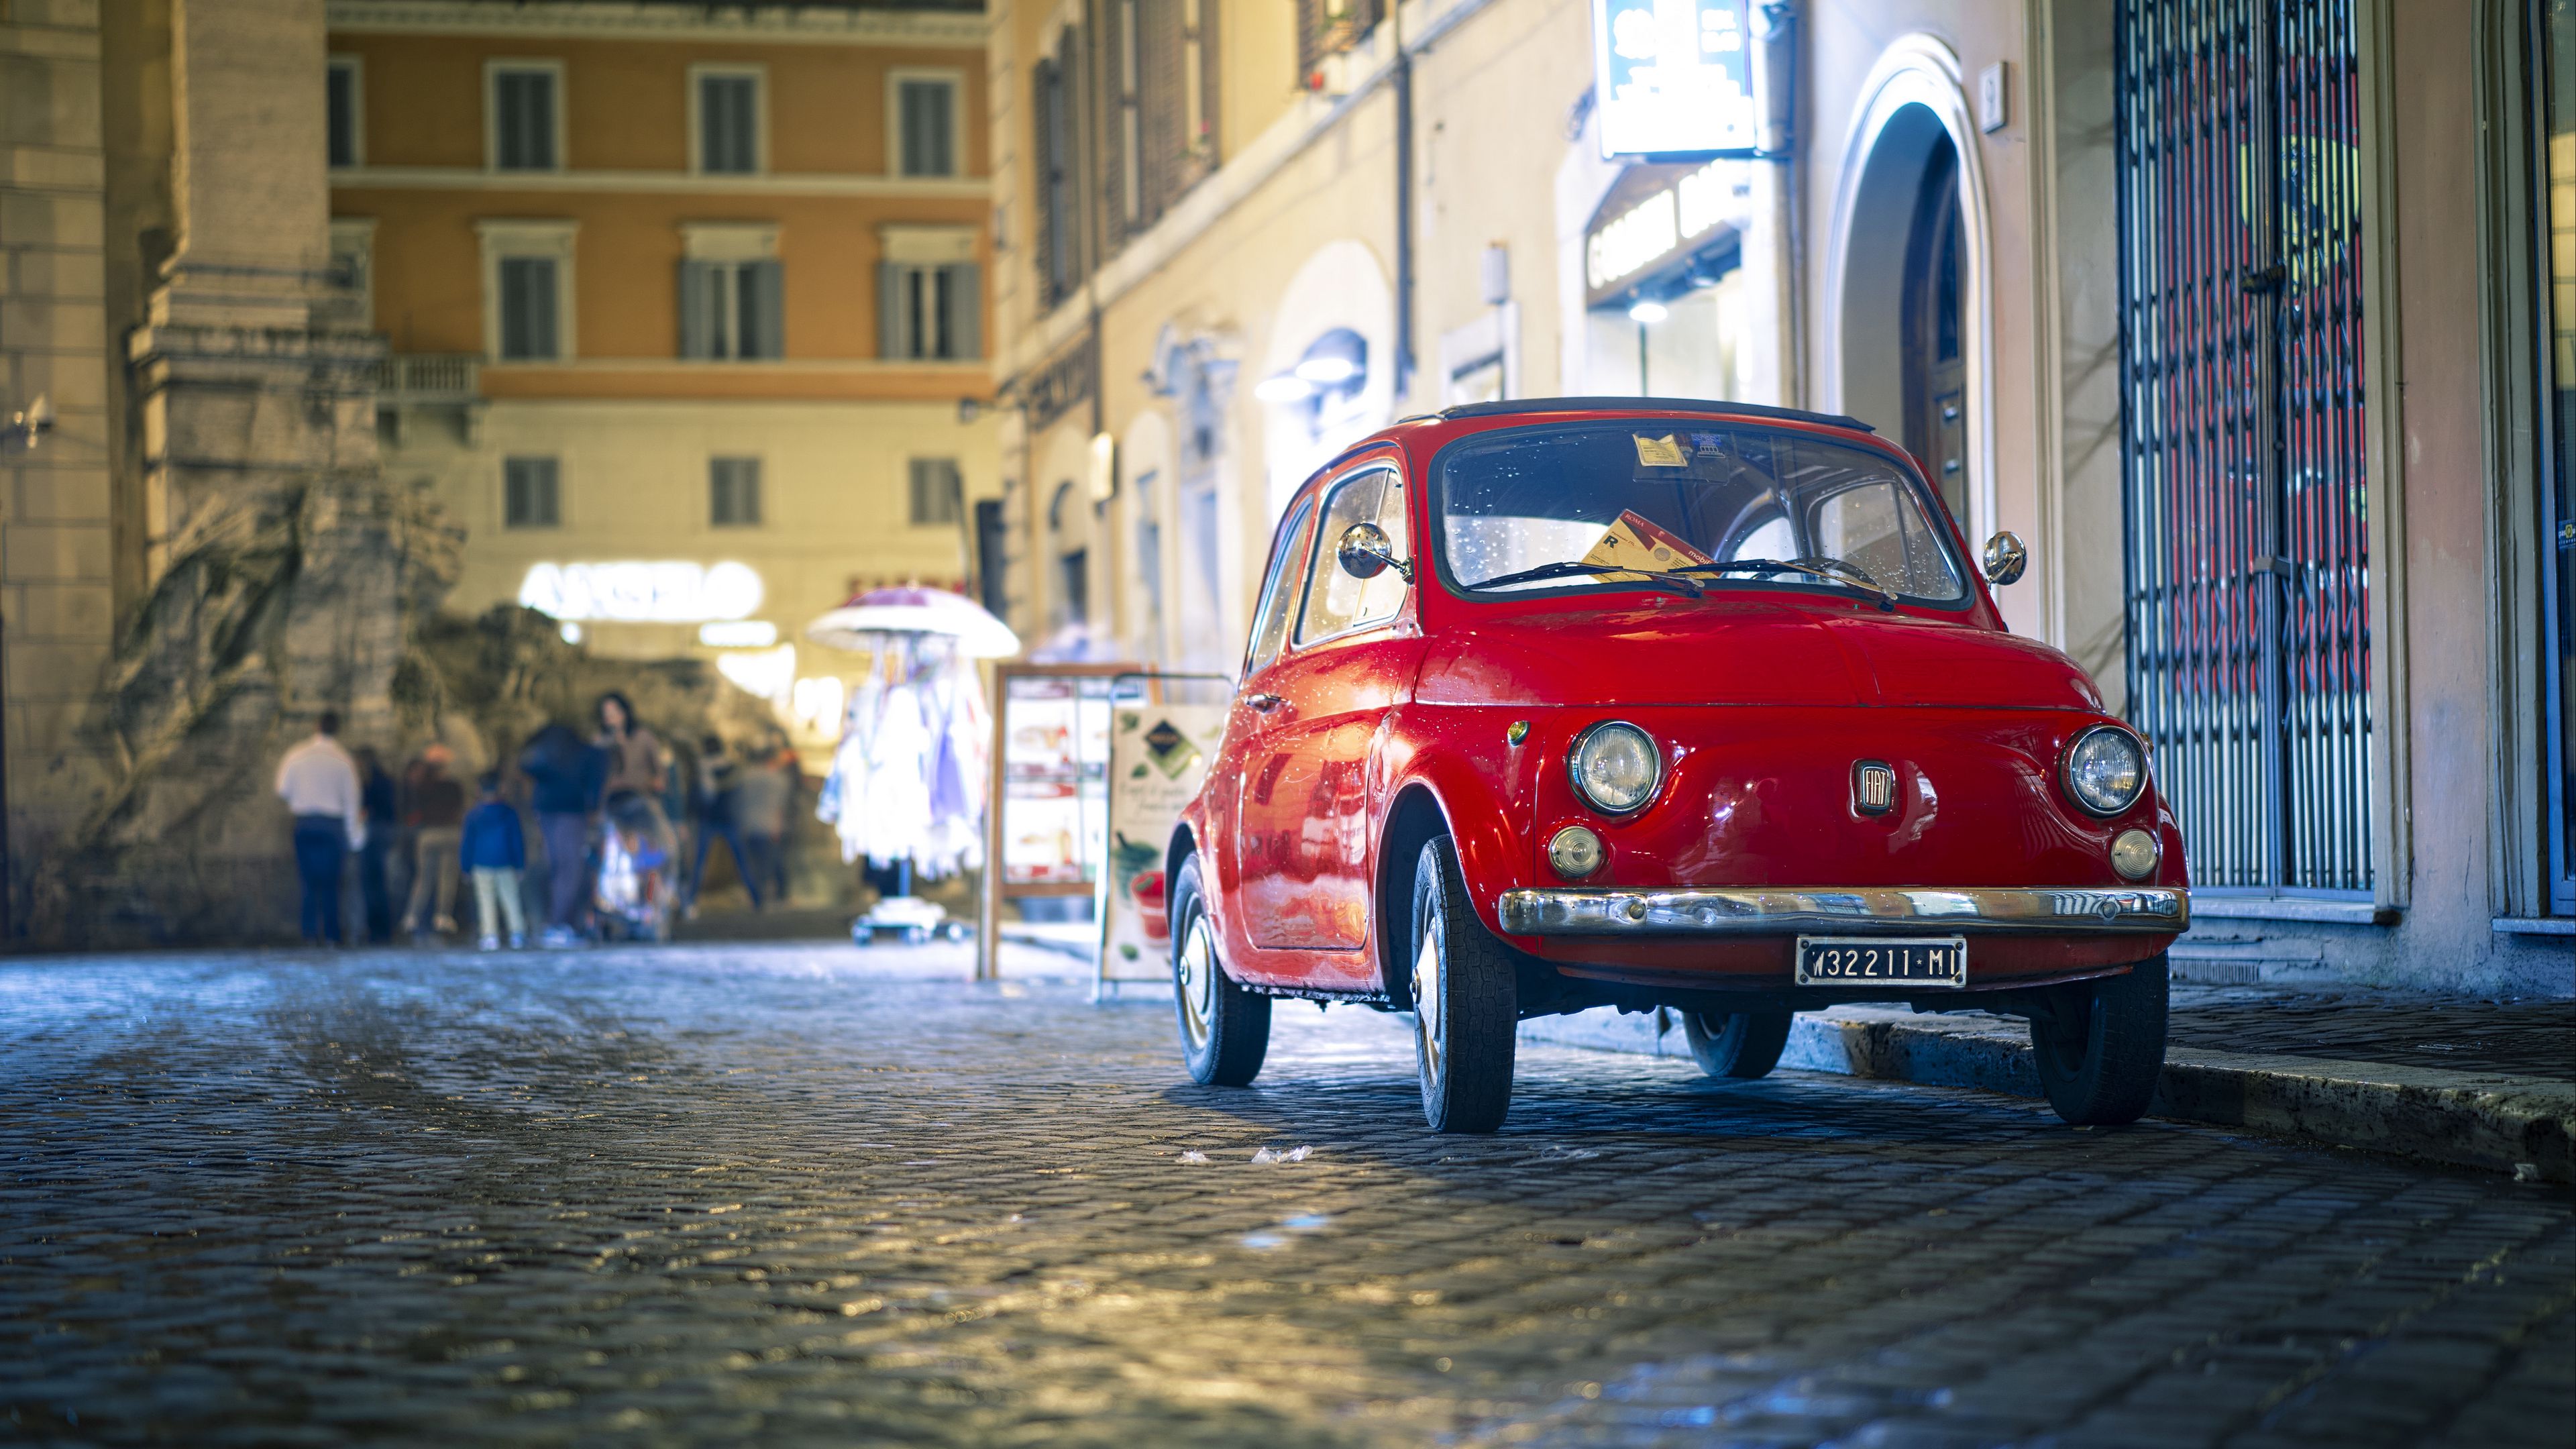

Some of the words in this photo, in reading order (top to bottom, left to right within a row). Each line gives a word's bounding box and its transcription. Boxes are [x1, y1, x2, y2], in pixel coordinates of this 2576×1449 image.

[1625, 514, 1644, 527] ROMA
[1603, 535, 1618, 549] R
[1866, 770, 1886, 805] FIAT
[1929, 949, 1955, 976] MI
